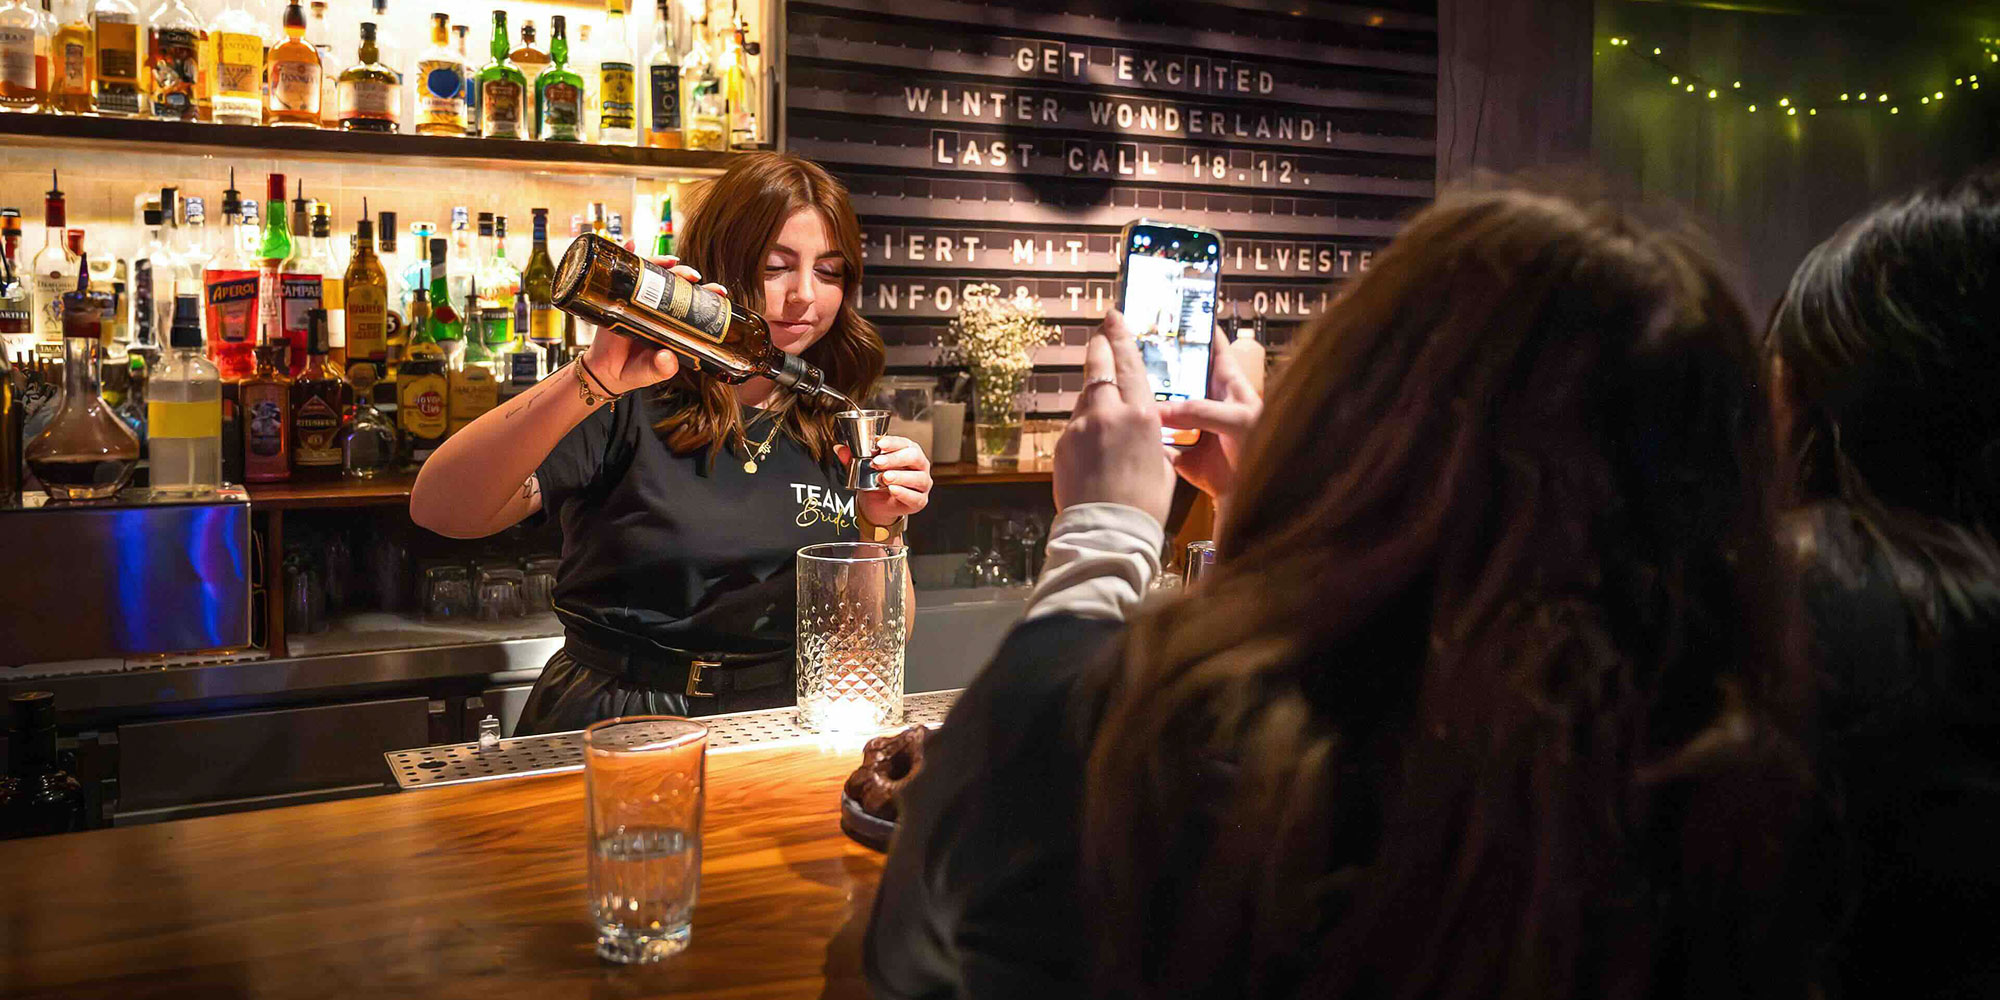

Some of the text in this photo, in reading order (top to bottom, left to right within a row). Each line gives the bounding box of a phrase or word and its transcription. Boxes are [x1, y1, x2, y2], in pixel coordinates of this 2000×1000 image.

[1016, 47, 1274, 94] GET EXCITED
[905, 86, 1333, 143] WINTER WONDERLAND!
[937, 138, 1034, 167] LAST
[1068, 146, 1158, 175] CALL
[1012, 238, 1083, 266] MIT
[1220, 246, 1372, 273] ILVESTE
[212, 283, 255, 302] APEROL
[1253, 290, 1343, 315] ONLI
[0, 311, 29, 319] ARTELL
[789, 483, 855, 518] TEAM
[796, 496, 851, 535] Bride
